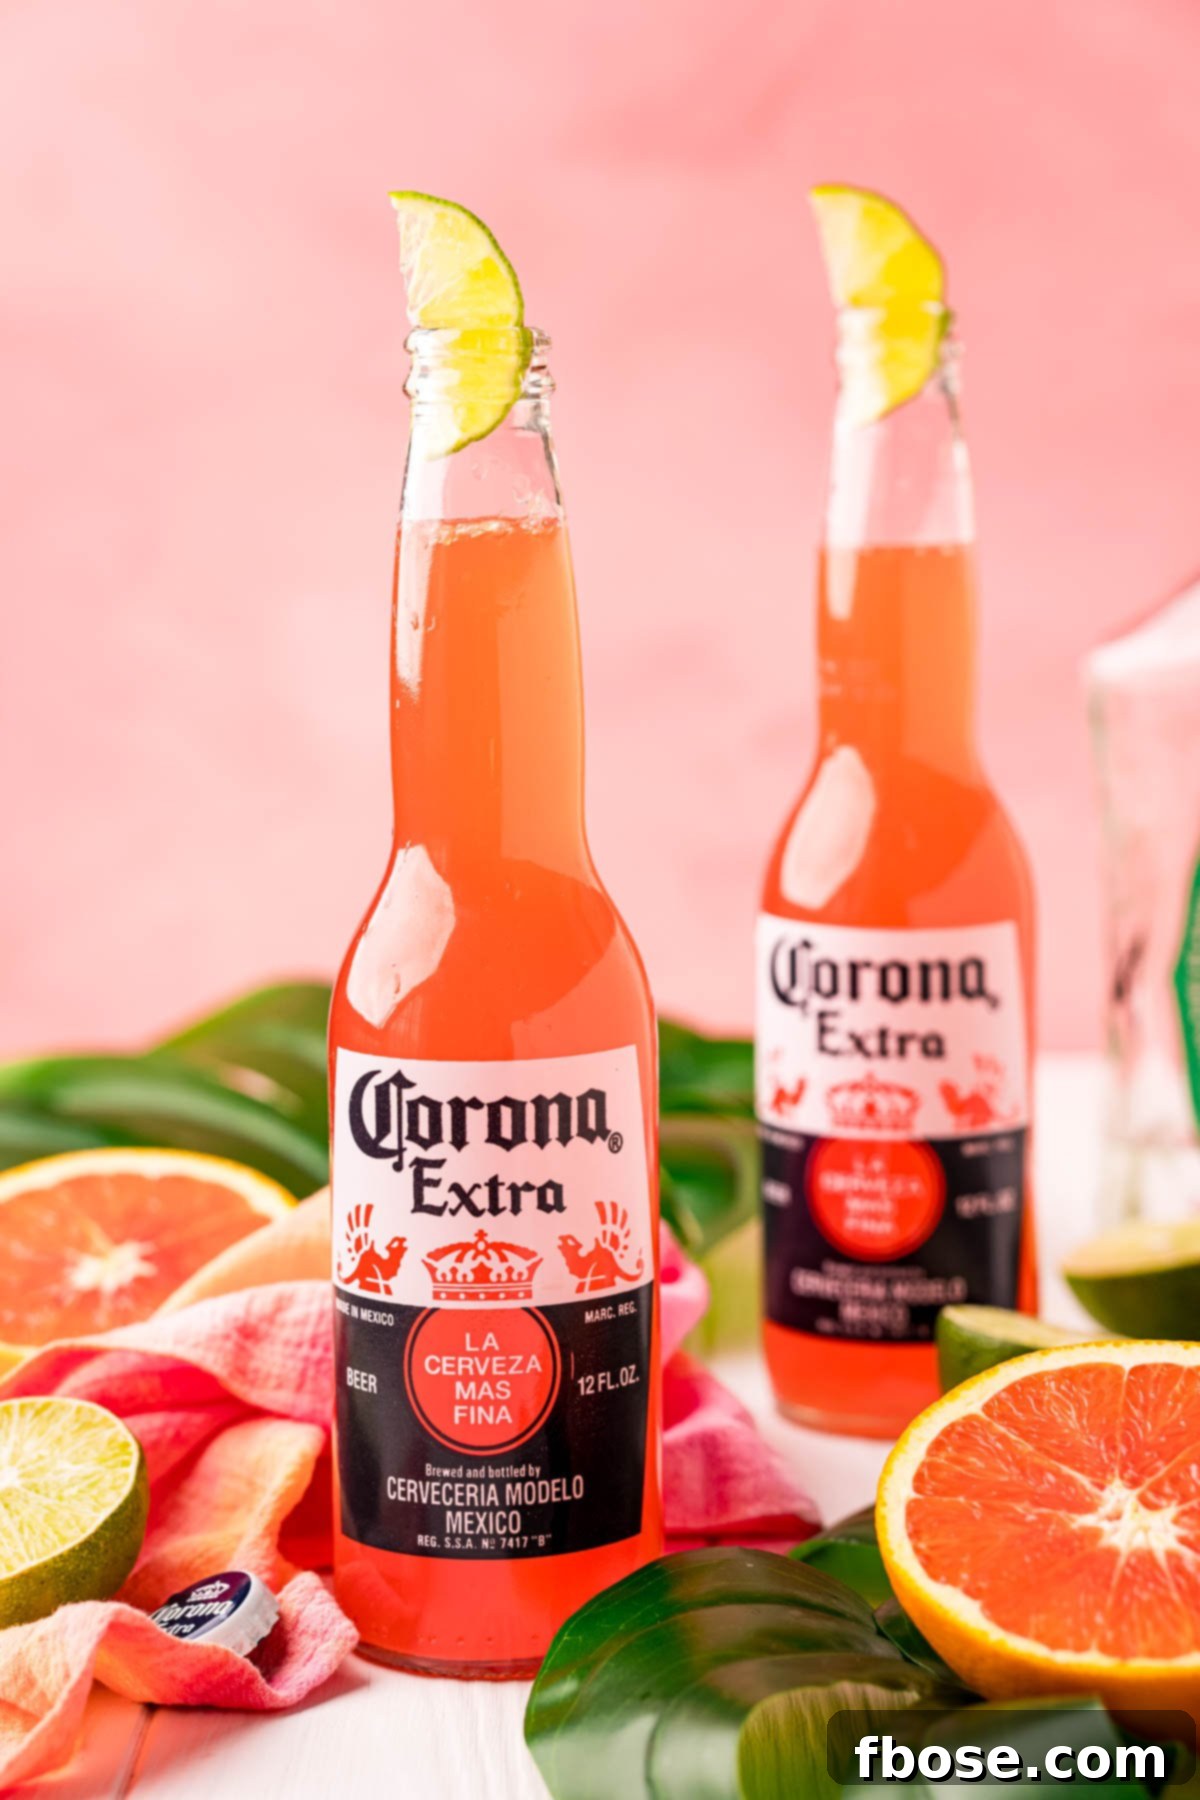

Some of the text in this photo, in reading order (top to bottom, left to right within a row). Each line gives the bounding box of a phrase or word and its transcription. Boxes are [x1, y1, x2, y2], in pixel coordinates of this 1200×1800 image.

[817, 1010, 946, 1059] Extra
[409, 1157, 567, 1217] Extra
[360, 1307, 394, 1326] MEXICO
[584, 1301, 637, 1324] MARC. REG.
[465, 1332, 499, 1351] LA
[424, 1355, 542, 1376] CERVEZA
[346, 1367, 378, 1394] BEER
[455, 1381, 511, 1400] MAS
[577, 1376, 595, 1396] 12
[454, 1405, 513, 1424] FINA
[425, 1463, 541, 1478] Brewed and bottled by
[387, 1475, 584, 1506] CERVECERIA MODELO
[446, 1511, 521, 1535] MEXICO
[417, 1535, 440, 1548] REG.
[500, 1536, 528, 1548] 7417
